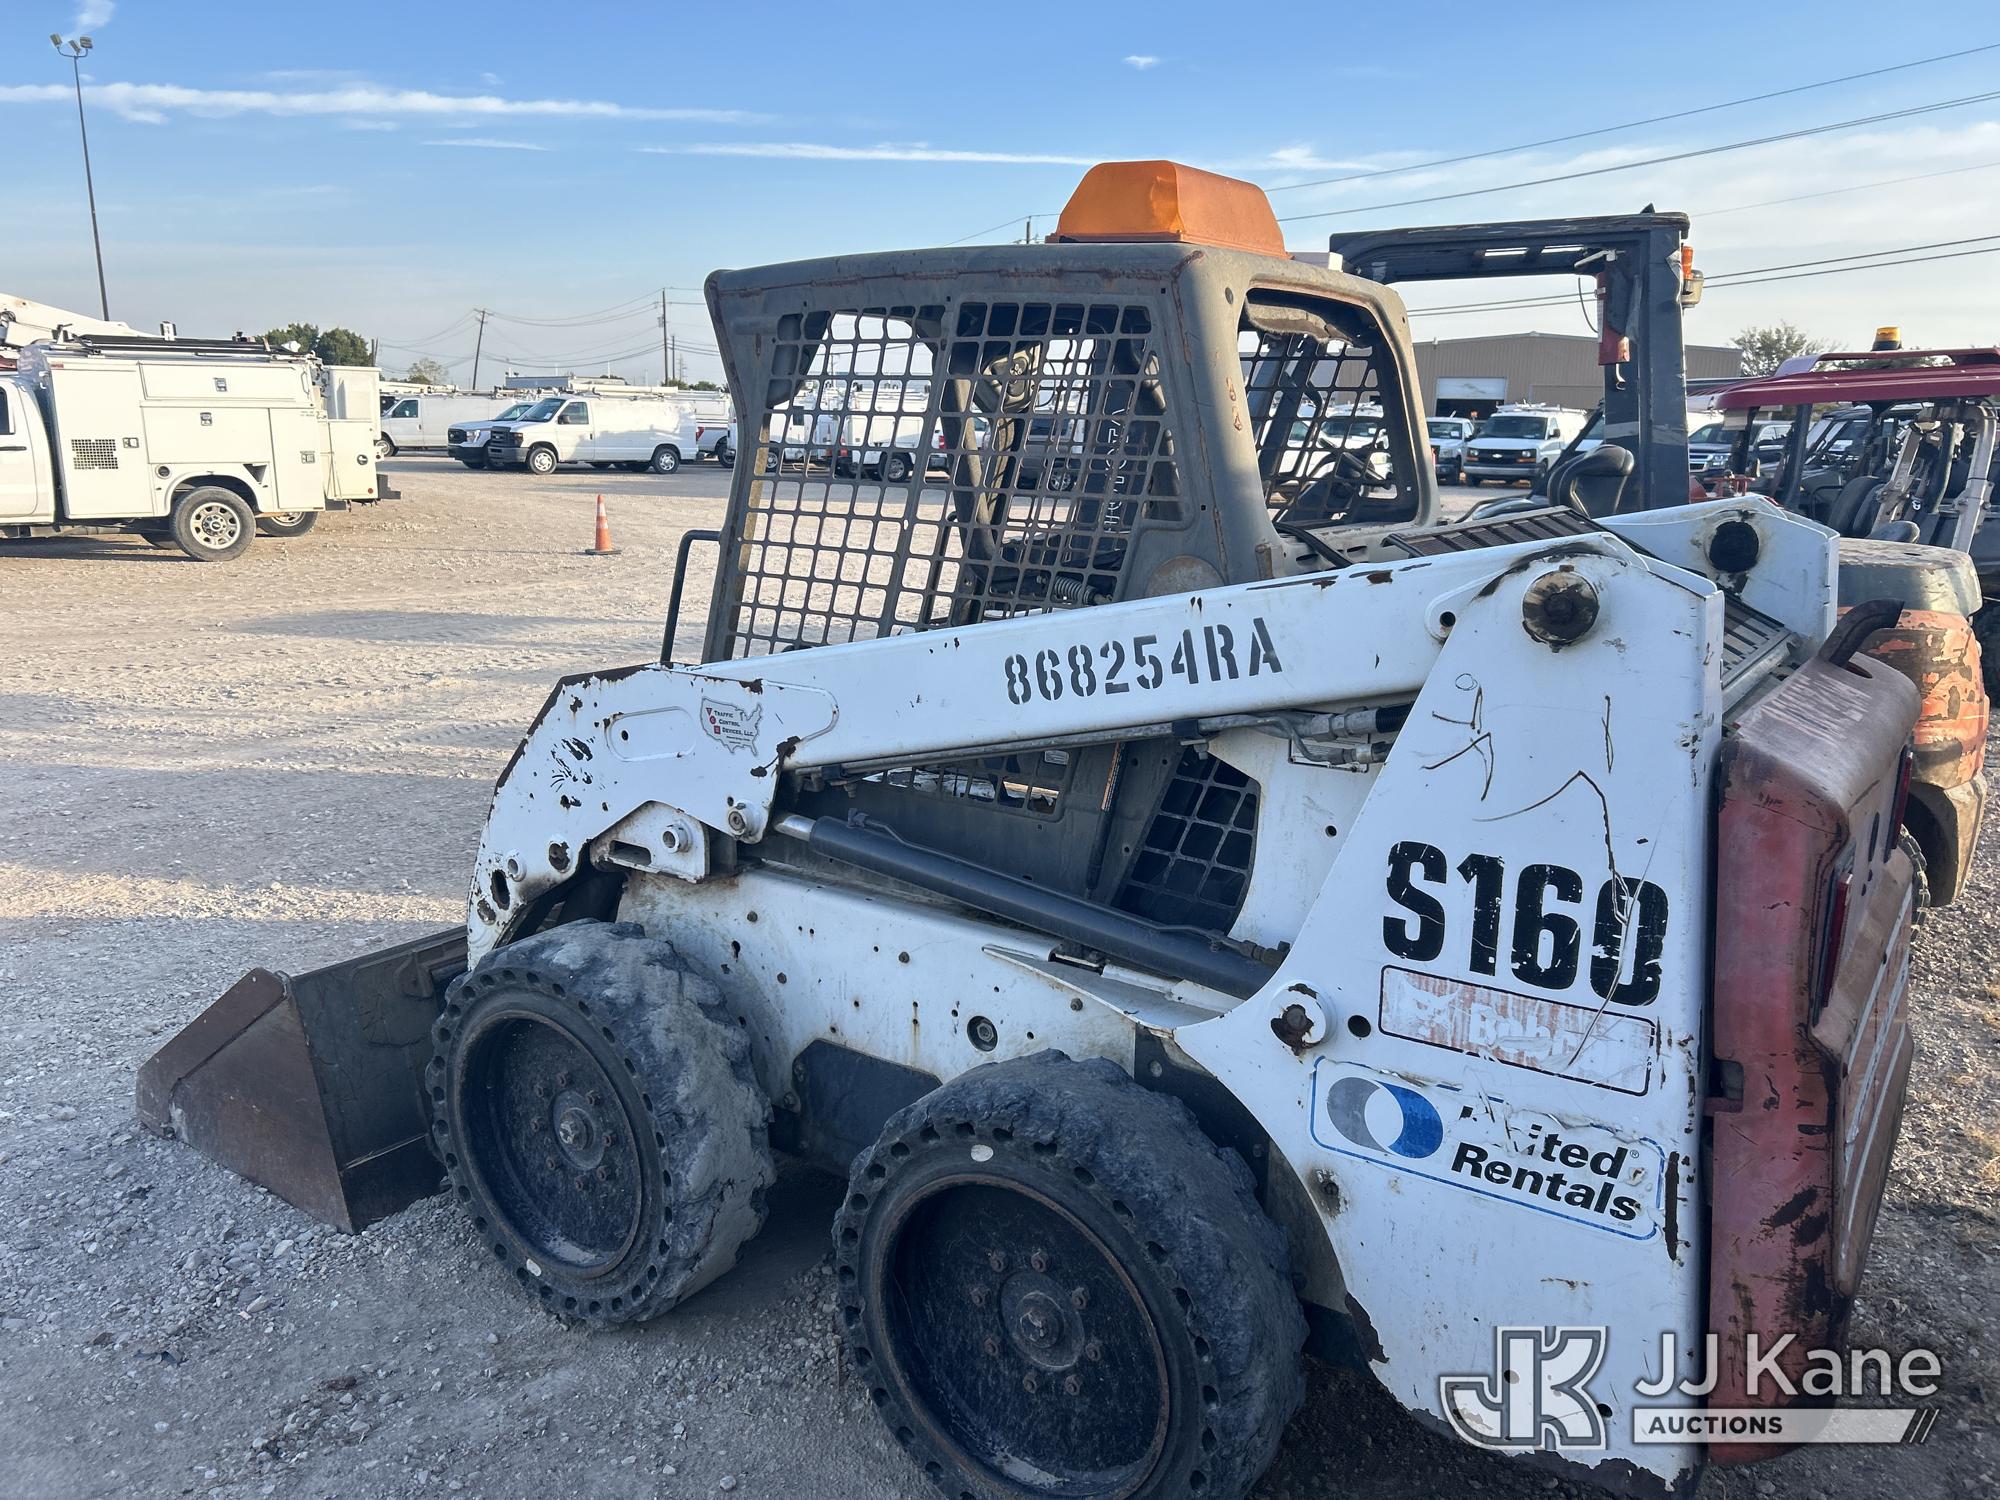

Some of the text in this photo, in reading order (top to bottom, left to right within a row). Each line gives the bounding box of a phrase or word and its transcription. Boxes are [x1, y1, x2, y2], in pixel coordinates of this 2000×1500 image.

[1004, 617, 1282, 705] 868254RA
[1383, 840, 1669, 1007] S160
[1450, 1141, 1642, 1222] Rentals
[1457, 1104, 1631, 1181] ited
